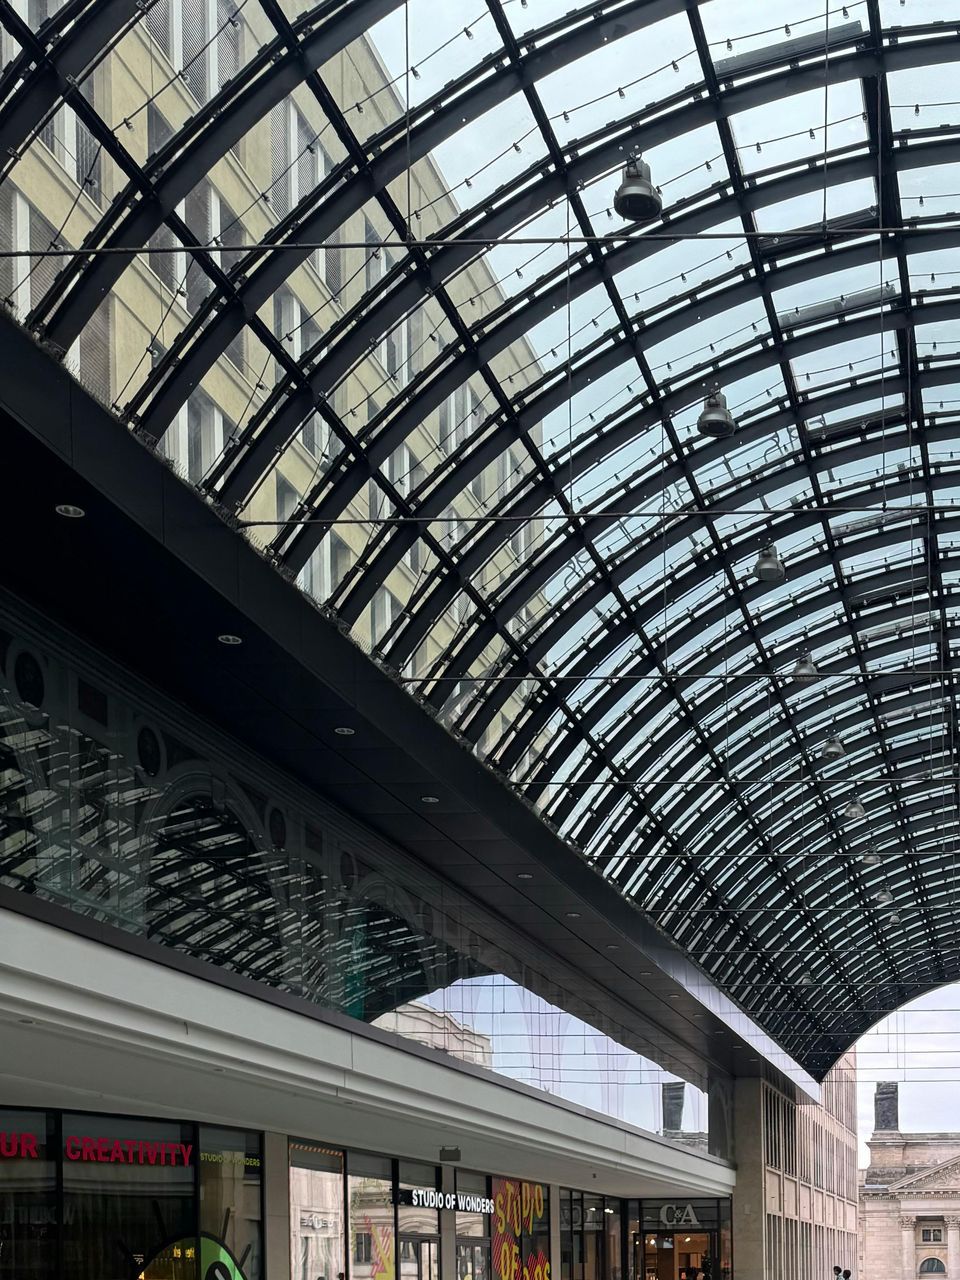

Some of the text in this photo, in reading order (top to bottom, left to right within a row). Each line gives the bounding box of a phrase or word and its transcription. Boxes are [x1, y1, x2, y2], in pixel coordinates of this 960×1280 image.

[65, 1135, 193, 1167] CREATIVITY
[412, 1189, 495, 1214] STUDIO OF WONDERS
[660, 1203, 700, 1225] C&A
